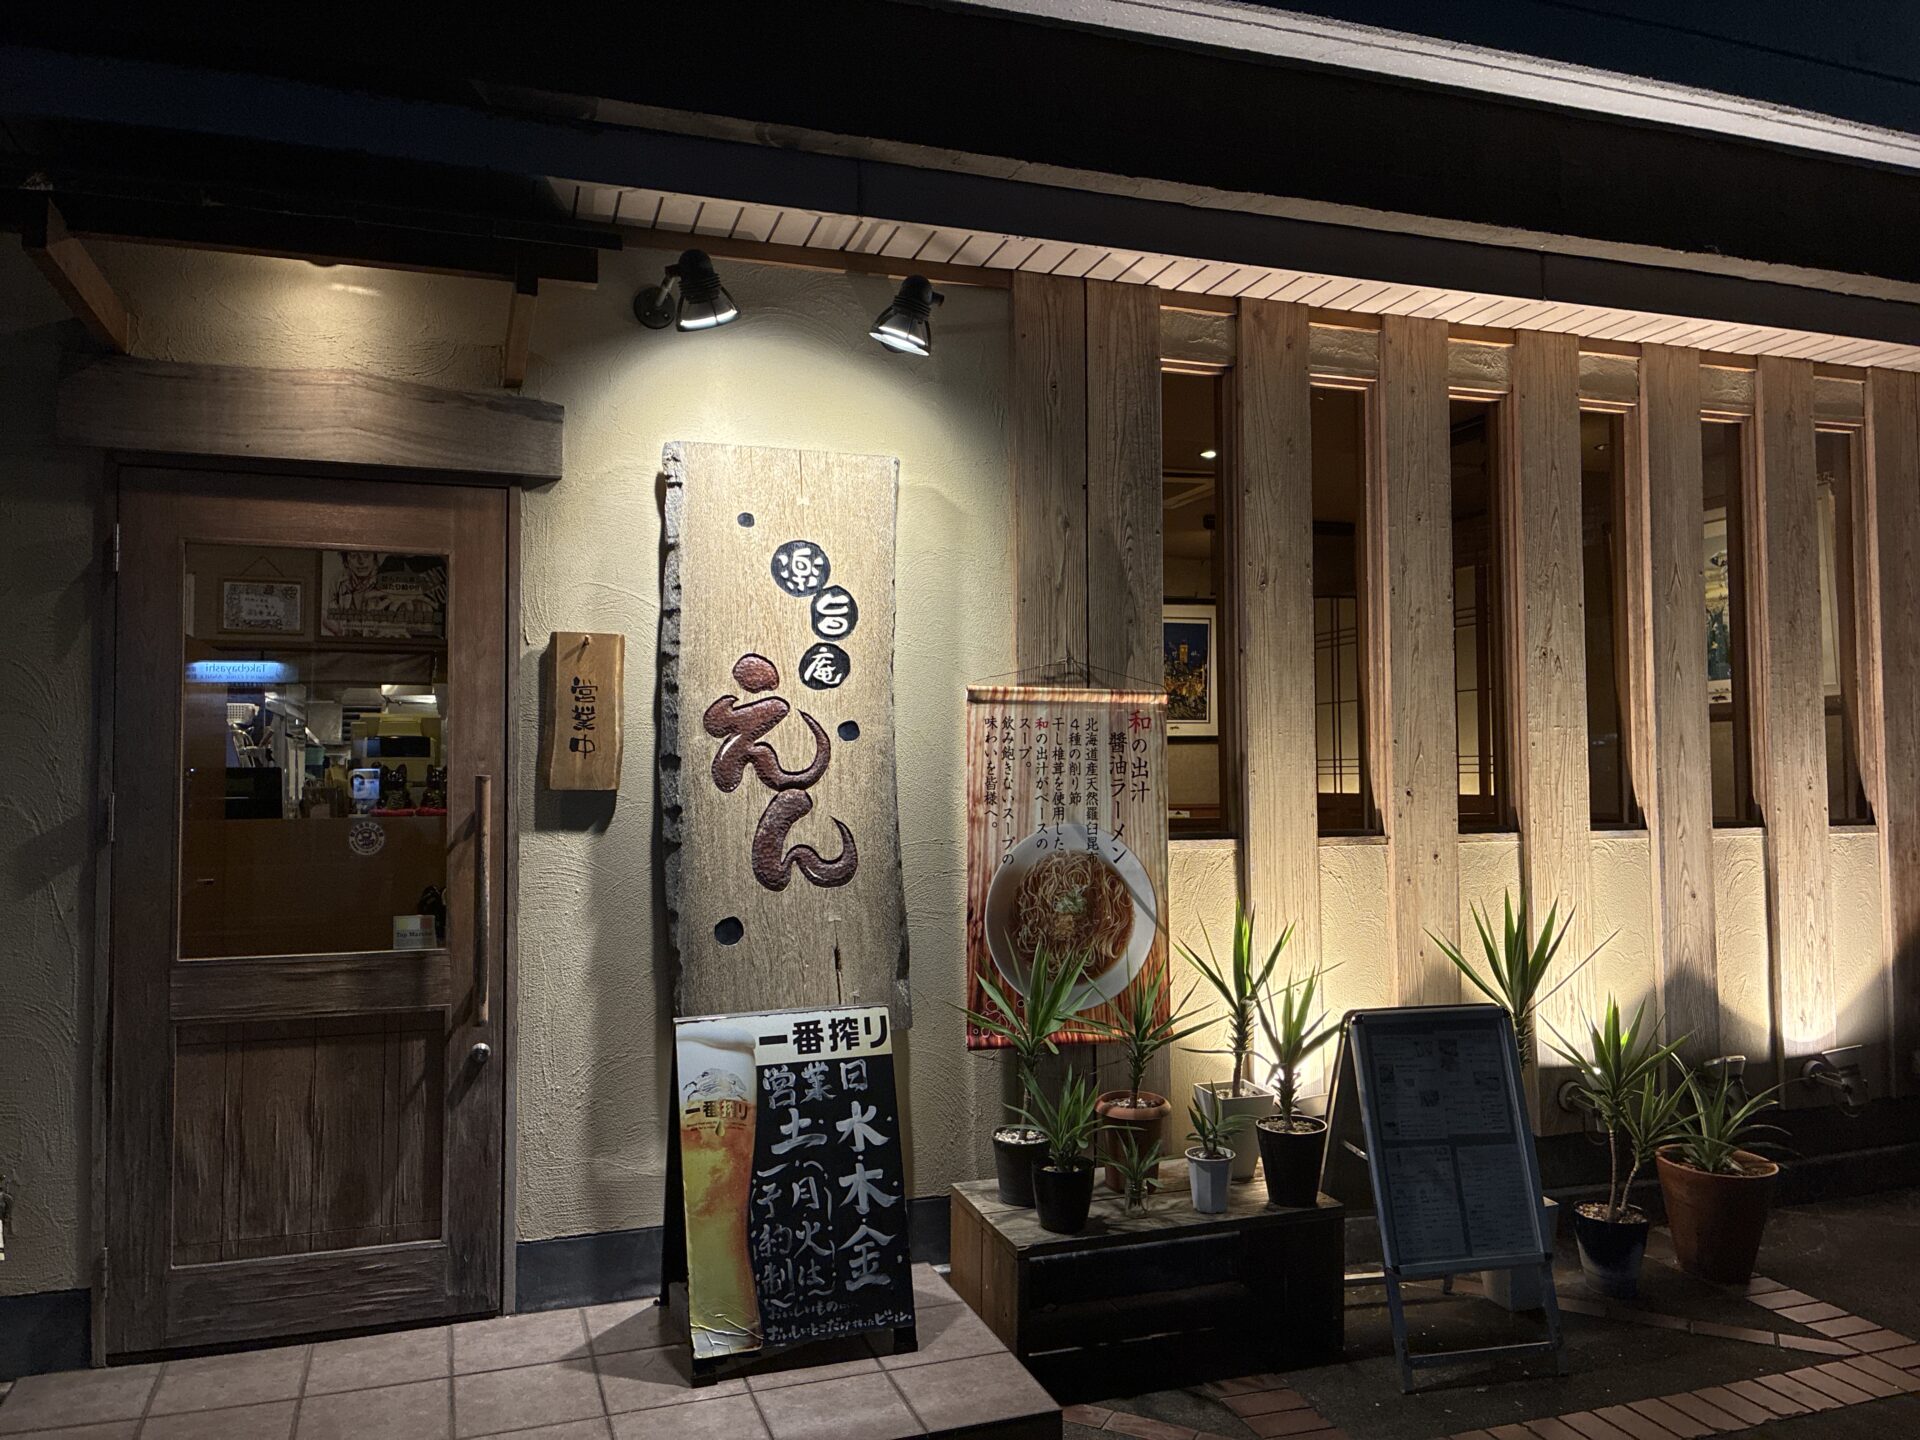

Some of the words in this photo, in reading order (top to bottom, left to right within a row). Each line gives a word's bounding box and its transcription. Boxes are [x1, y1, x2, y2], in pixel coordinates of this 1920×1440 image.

[703, 653, 858, 891] えん
[983, 717, 999, 830] 味わいを皆様へ。
[1001, 715, 1015, 866] 飲み飽きないスープの
[1019, 718, 1032, 769] スープ。
[1035, 718, 1049, 850] 和の出汁がベースの
[1051, 718, 1066, 851] 干し椎茸を使用した
[1085, 718, 1099, 864] 北海道産天然羅臼昆布
[1128, 711, 1151, 803] 和の出汁
[759, 1015, 888, 1055] 一番搾り
[762, 1058, 868, 1110] 営業日
[685, 1100, 748, 1120] 一番搾り
